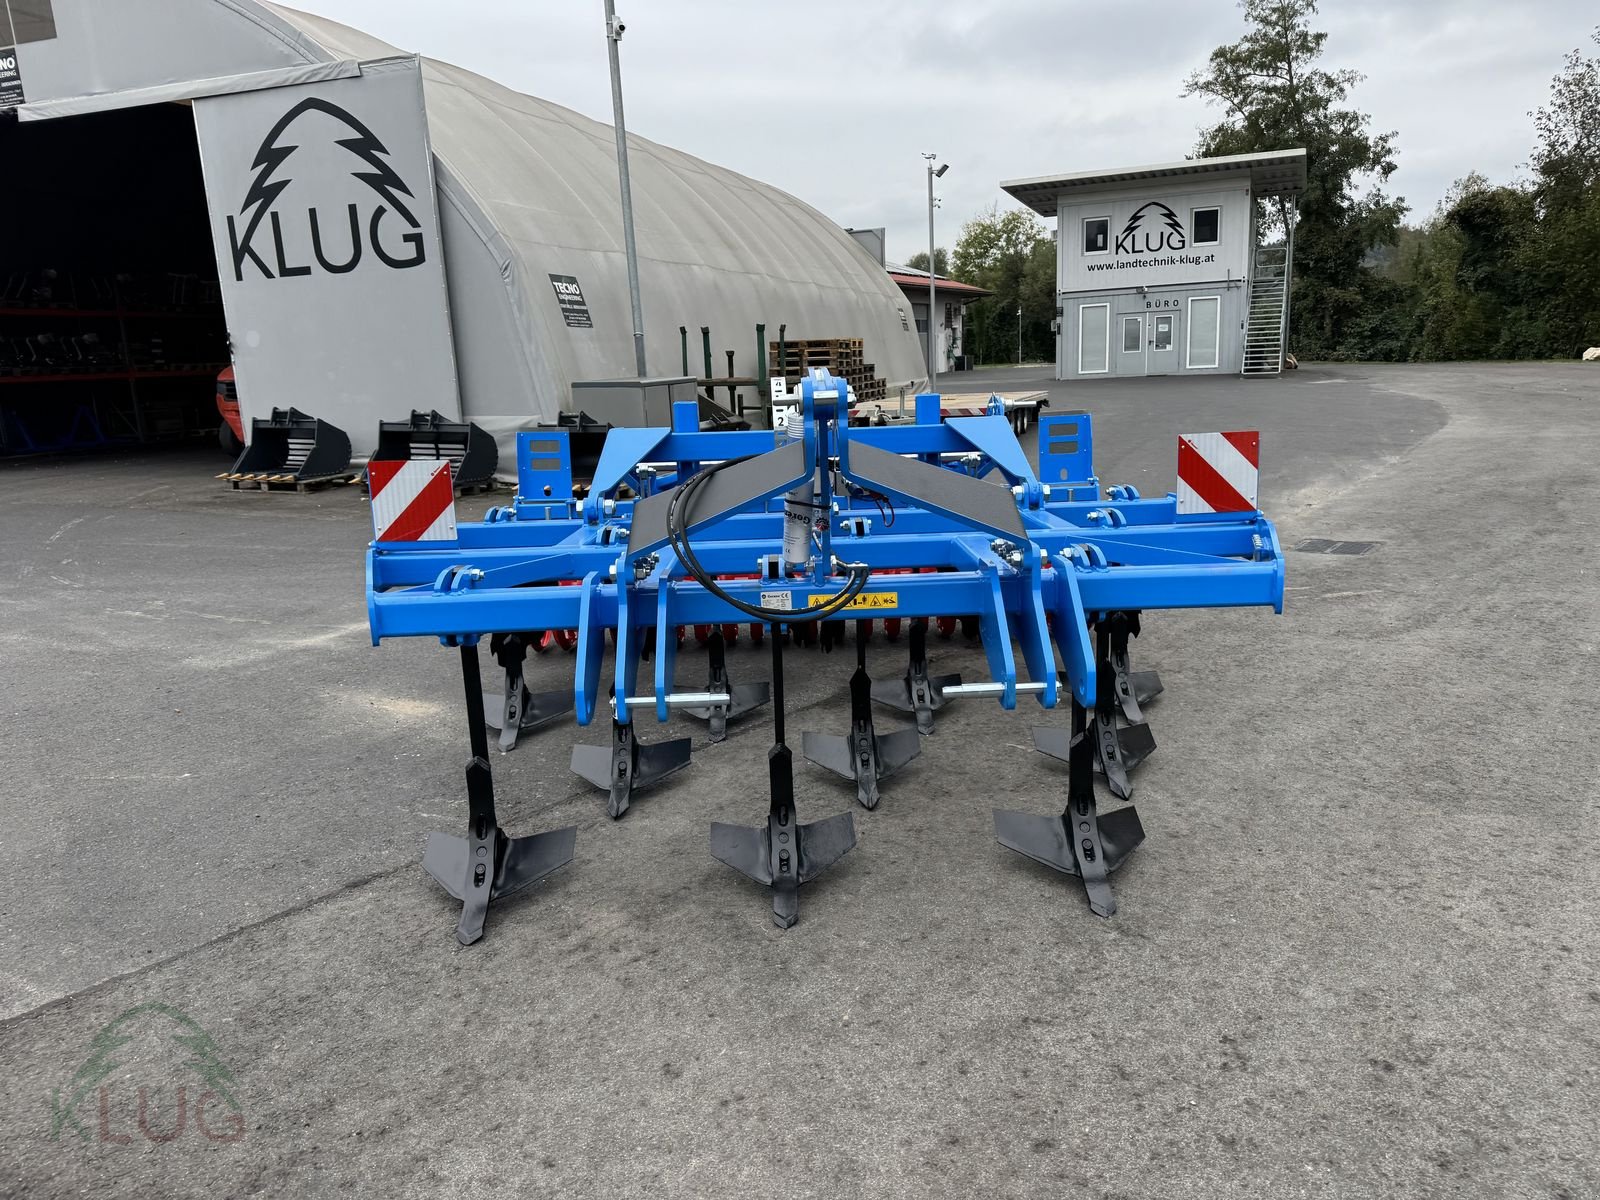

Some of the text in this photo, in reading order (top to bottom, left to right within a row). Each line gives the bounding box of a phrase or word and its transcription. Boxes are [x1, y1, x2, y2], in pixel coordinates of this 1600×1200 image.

[226, 203, 427, 282] KLUG
[1115, 231, 1186, 256] KLUG
[1087, 253, 1215, 272] www.landtechnik-klug.at
[552, 281, 580, 295] TECNO
[1146, 299, 1180, 309] BÜRO
[777, 416, 785, 427] 2
